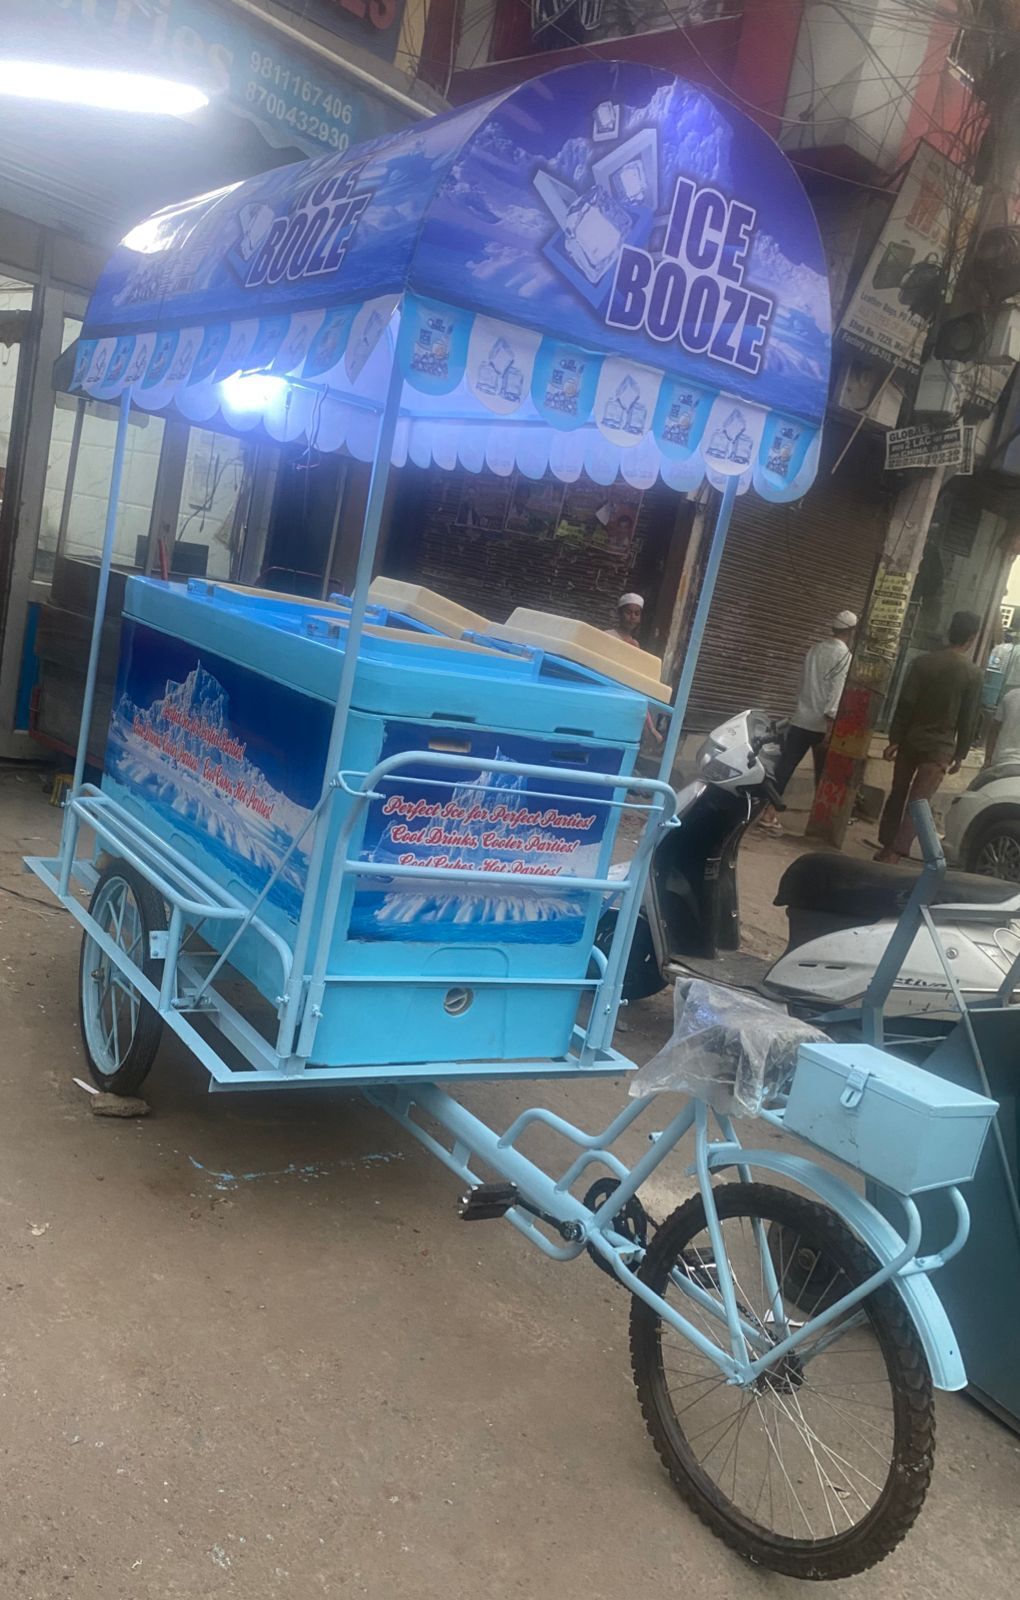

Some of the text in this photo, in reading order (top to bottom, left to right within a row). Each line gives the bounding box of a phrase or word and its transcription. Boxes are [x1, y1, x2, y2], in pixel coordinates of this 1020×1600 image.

[246, 81, 350, 151] 8700432930
[249, 51, 353, 125] 9811167406
[244, 192, 373, 288] BOOZE
[662, 176, 756, 285] ICE
[605, 243, 773, 375] BOOZE
[889, 427, 927, 442] GLOBAL
[912, 436, 932, 448] LAC
[383, 796, 597, 830] Perfect Ice for Perfect Parties!
[391, 824, 580, 854] Cool Drinks, Cooler Parties!
